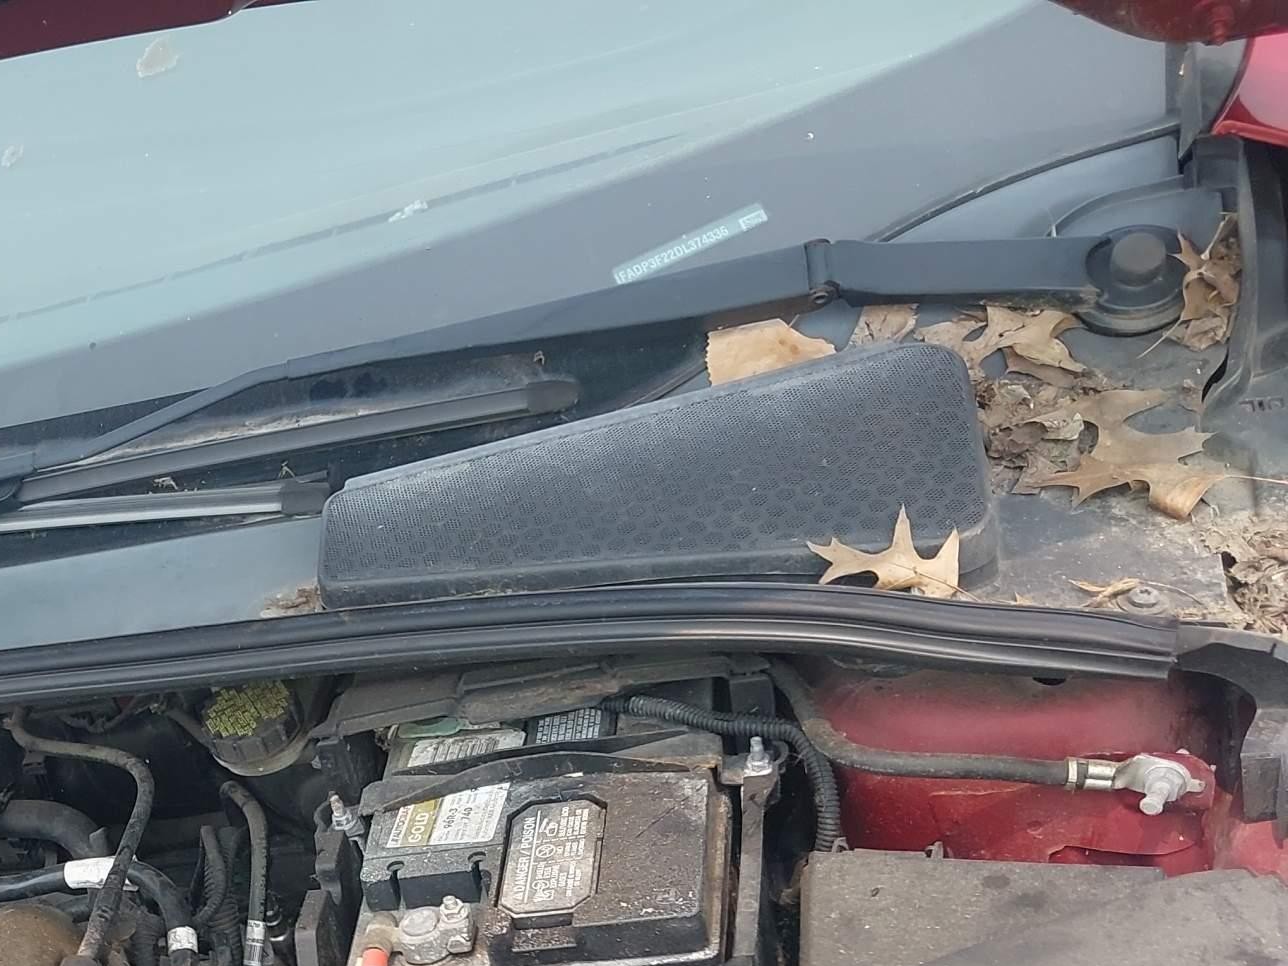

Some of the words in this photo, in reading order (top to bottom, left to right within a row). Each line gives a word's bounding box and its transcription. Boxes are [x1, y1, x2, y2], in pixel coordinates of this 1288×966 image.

[408, 812, 430, 843] GOLD
[461, 807, 473, 821] 740
[521, 817, 536, 848] POISON
[513, 857, 530, 892] DANGER
